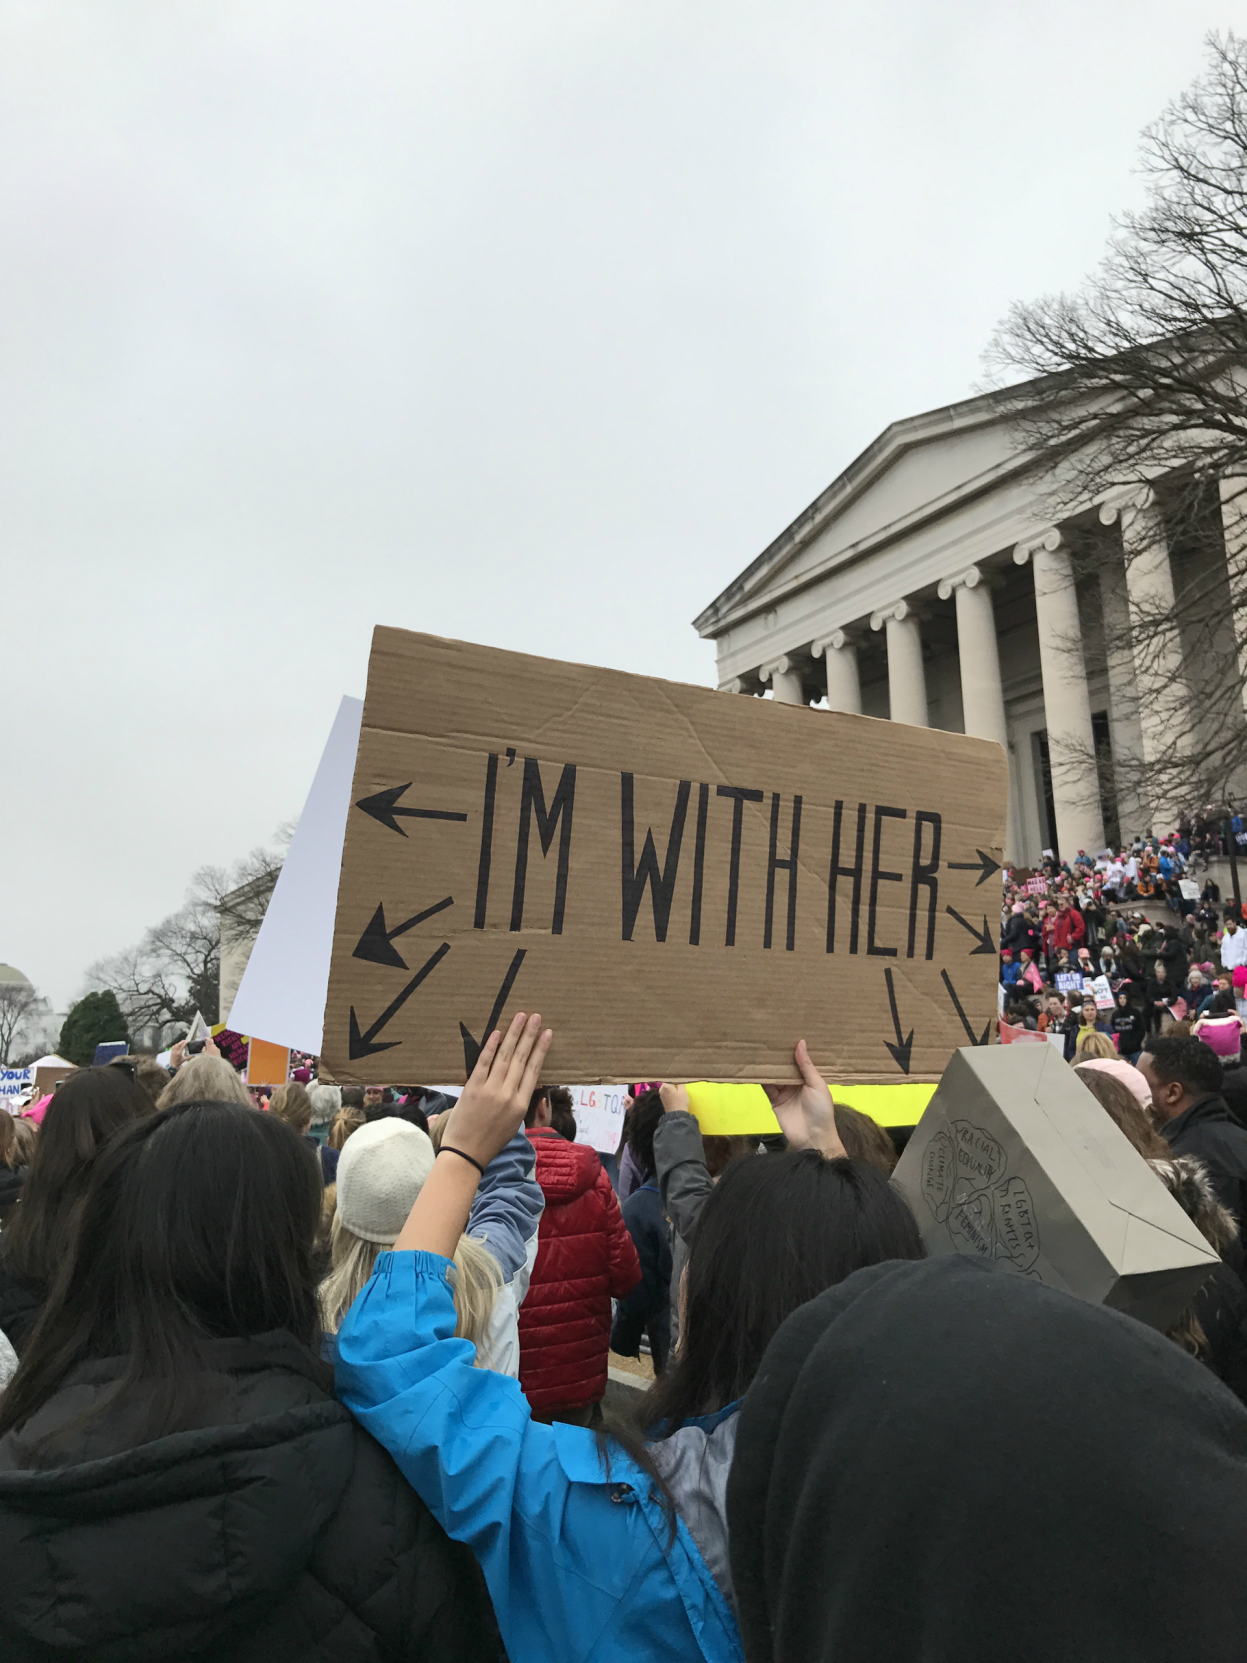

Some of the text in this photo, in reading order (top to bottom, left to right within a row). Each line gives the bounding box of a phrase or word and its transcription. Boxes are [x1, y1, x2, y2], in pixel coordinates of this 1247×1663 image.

[474, 747, 942, 961] I'M WITH HER
[1058, 981, 1081, 990] RIGHT
[0, 1069, 31, 1080] YOUR
[961, 1129, 996, 1162] RACIAL
[936, 1147, 946, 1191] CLIMATE
[958, 1148, 997, 1184] EQUALITY
[955, 1209, 989, 1255] FEMINISM
[1000, 1203, 1021, 1250] RIGHTS
